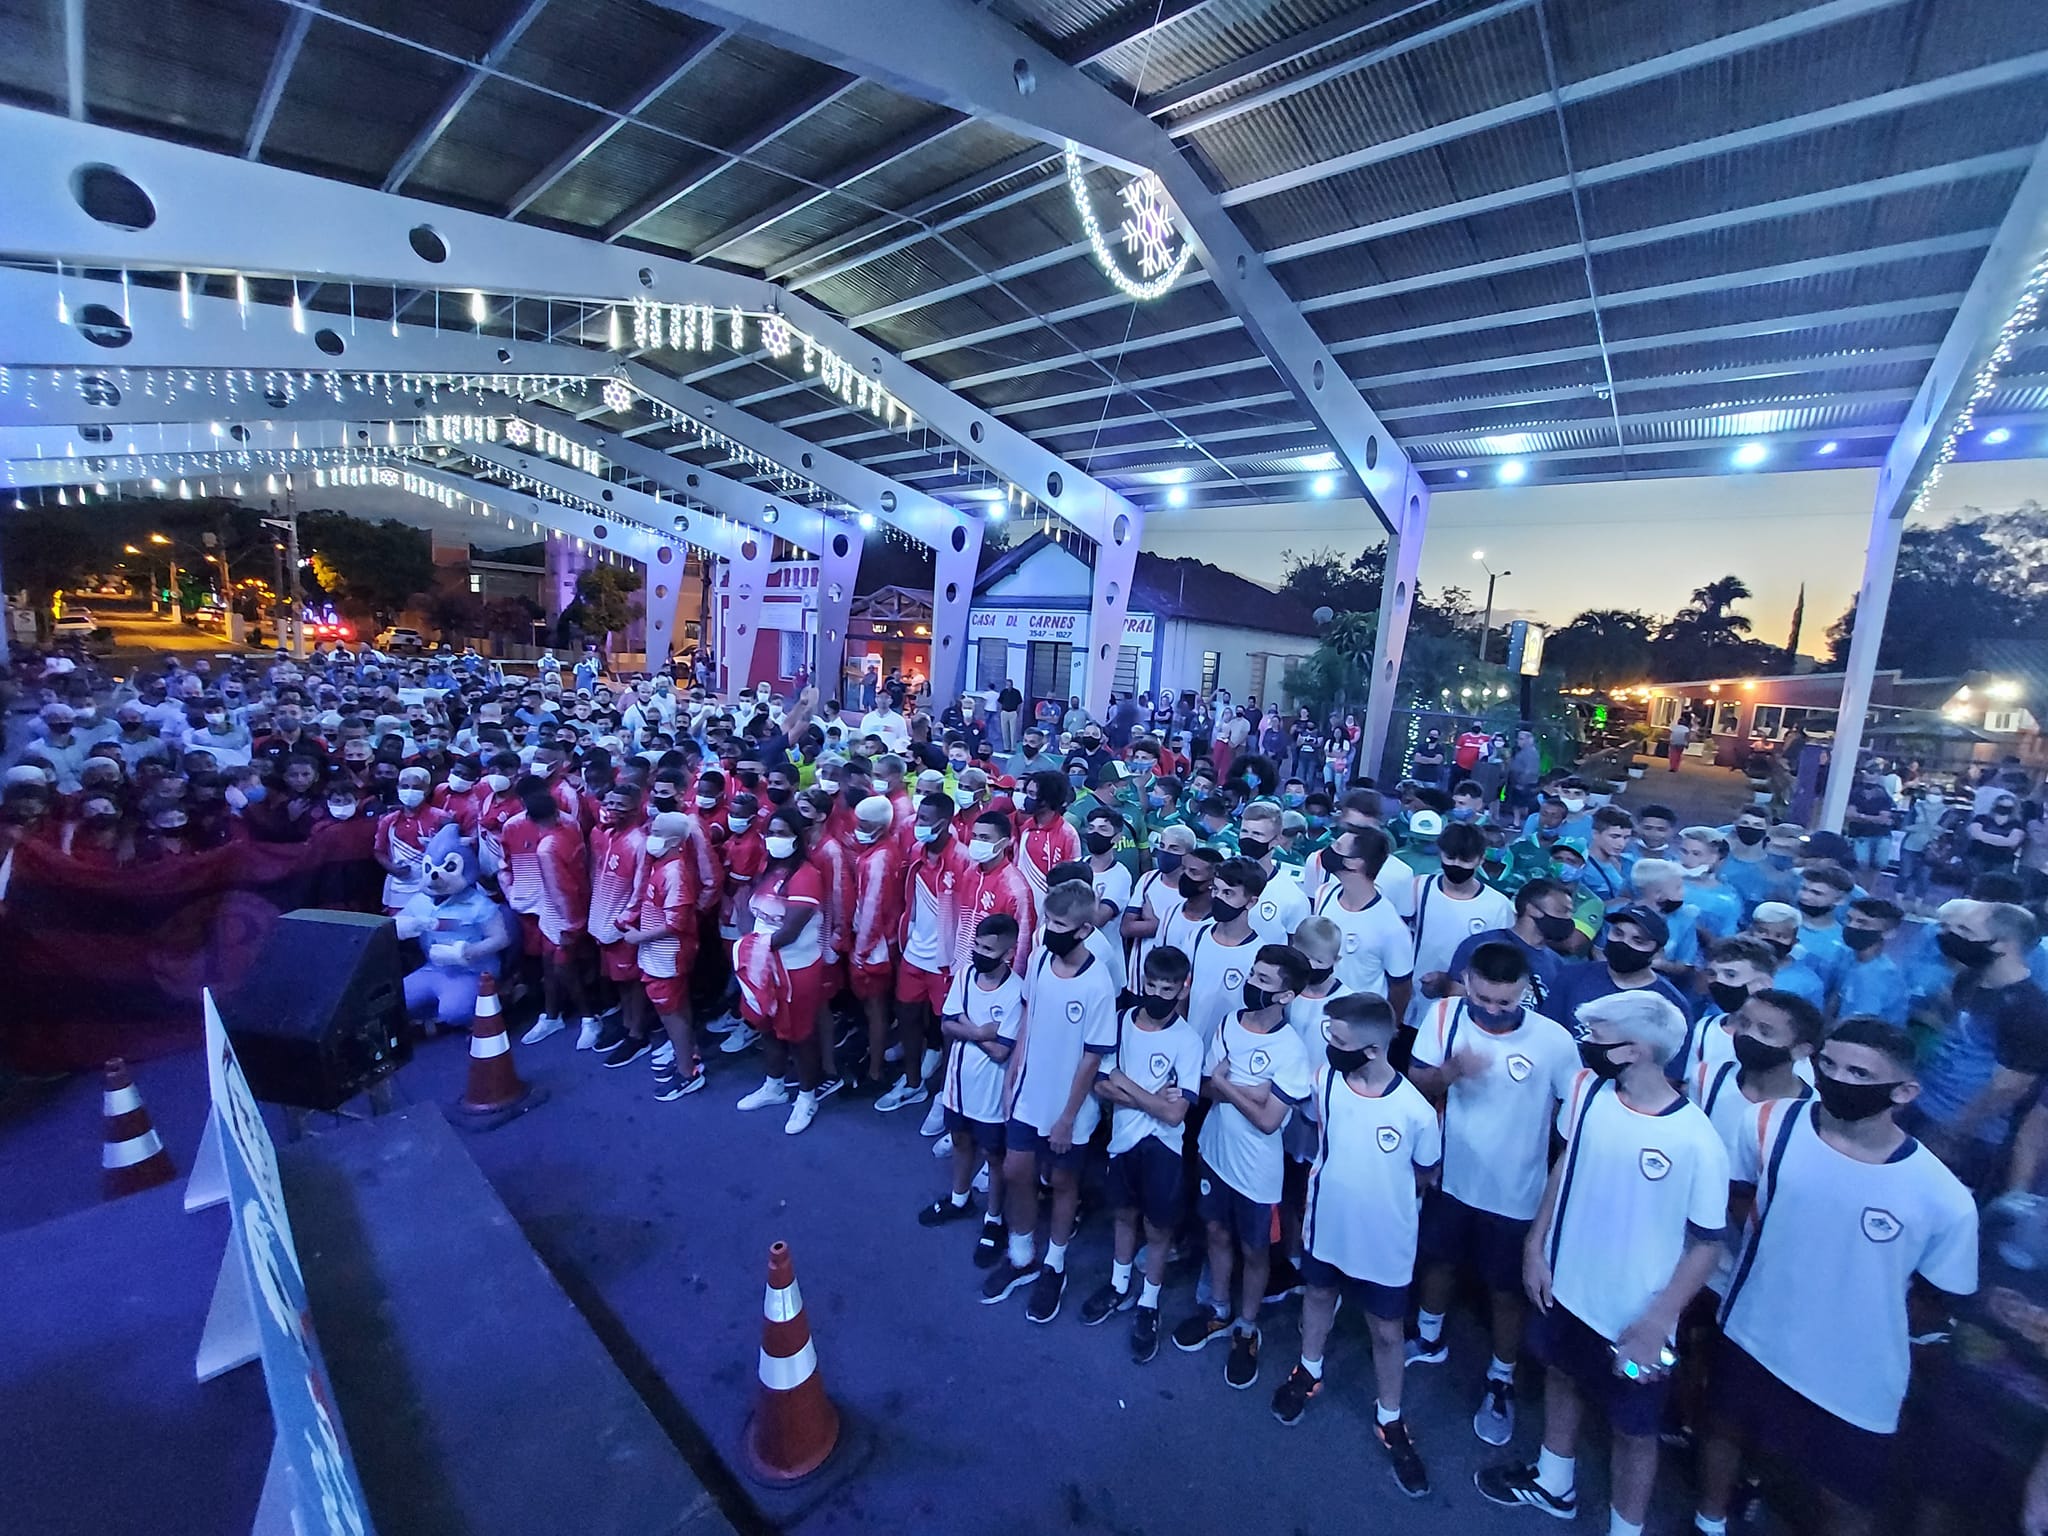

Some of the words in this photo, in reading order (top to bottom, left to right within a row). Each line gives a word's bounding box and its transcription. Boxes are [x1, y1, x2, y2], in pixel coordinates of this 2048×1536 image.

[971, 614, 996, 626] CASA
[1029, 615, 1076, 629] CARNES
[1122, 618, 1154, 633] TRAL
